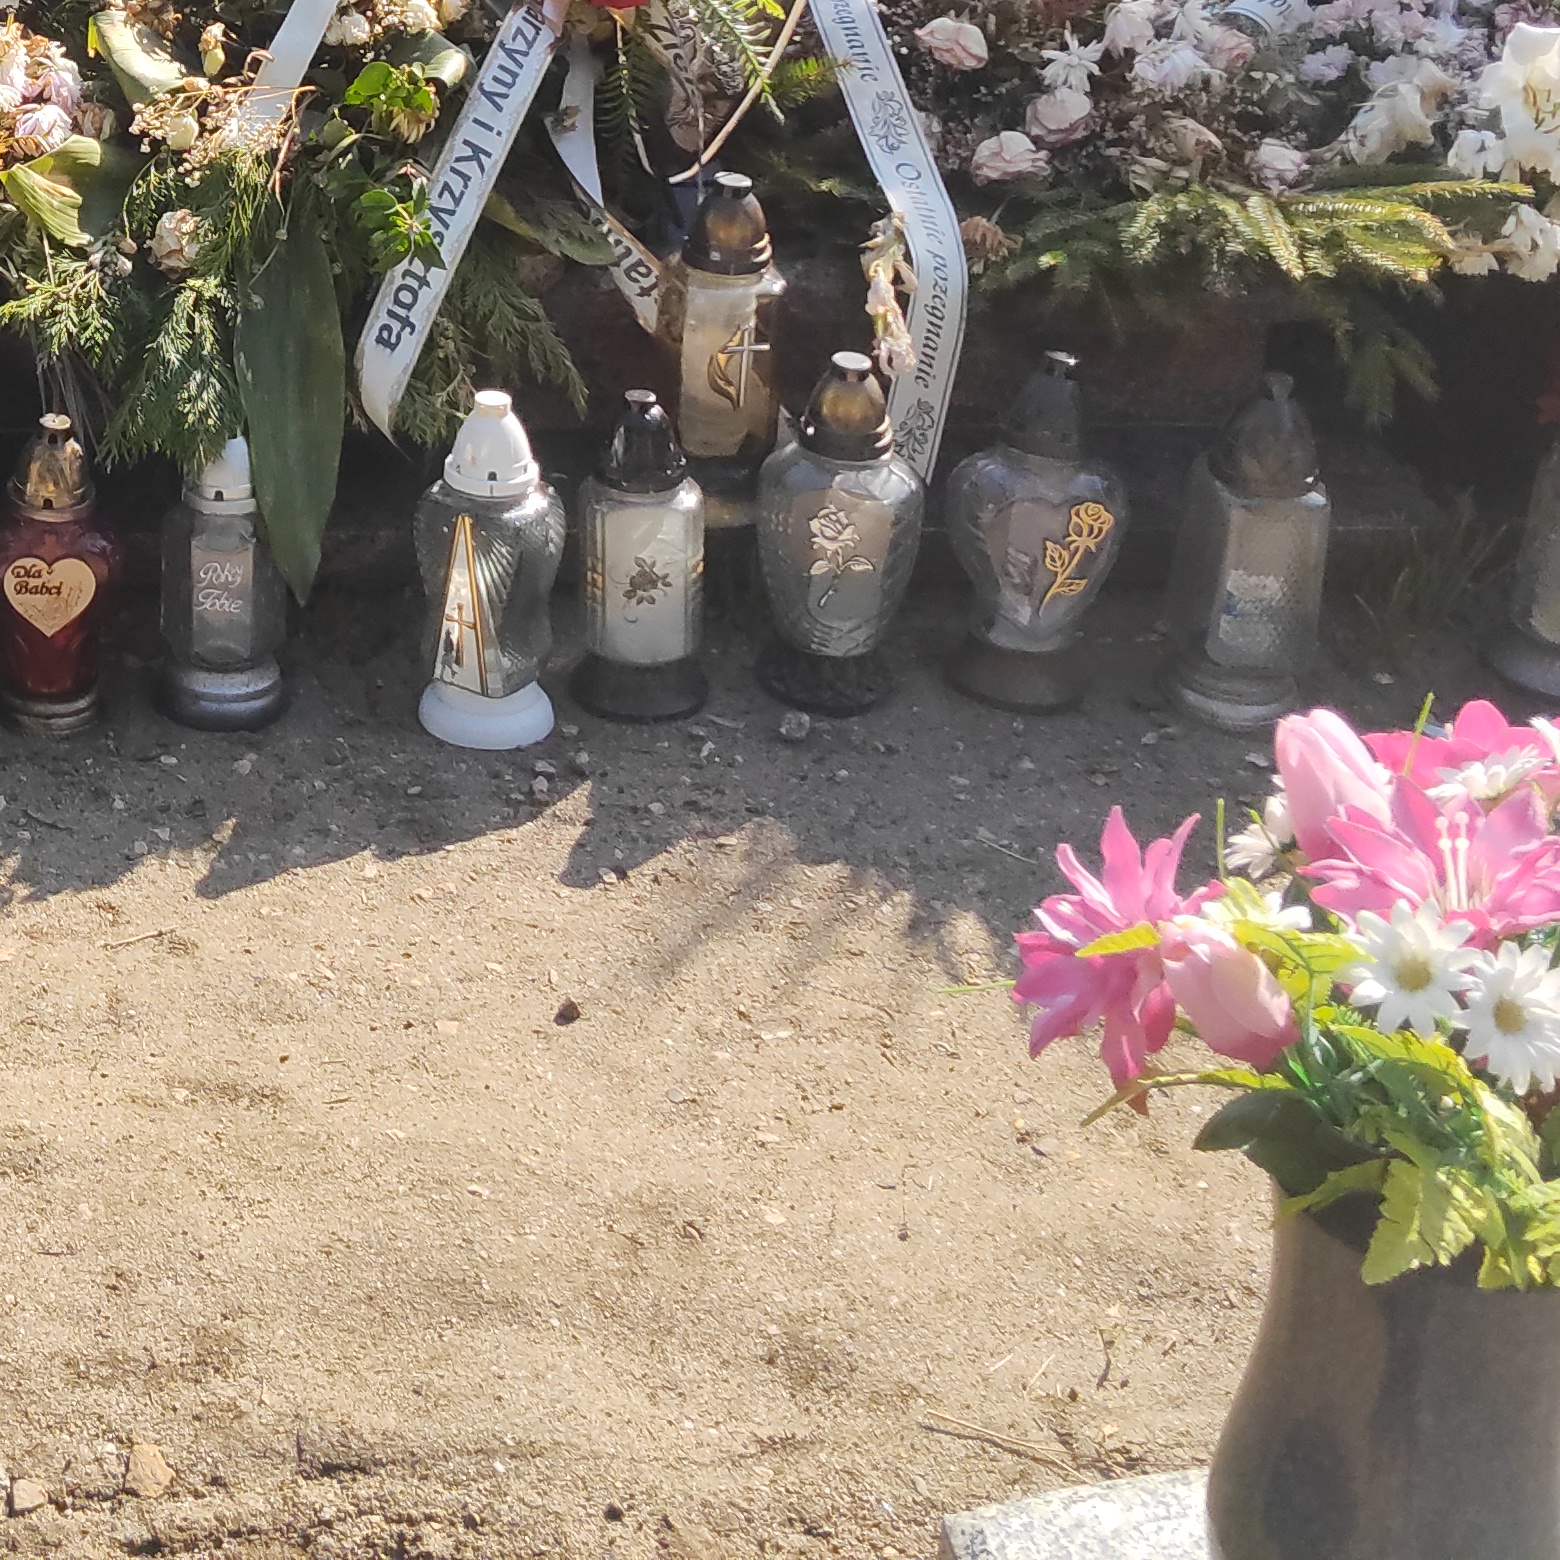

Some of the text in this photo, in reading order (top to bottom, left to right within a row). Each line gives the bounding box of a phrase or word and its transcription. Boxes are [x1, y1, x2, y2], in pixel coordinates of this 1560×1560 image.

[472, 115, 503, 137] i
[374, 137, 495, 355] Krzytofa
[10, 564, 44, 580] Dla
